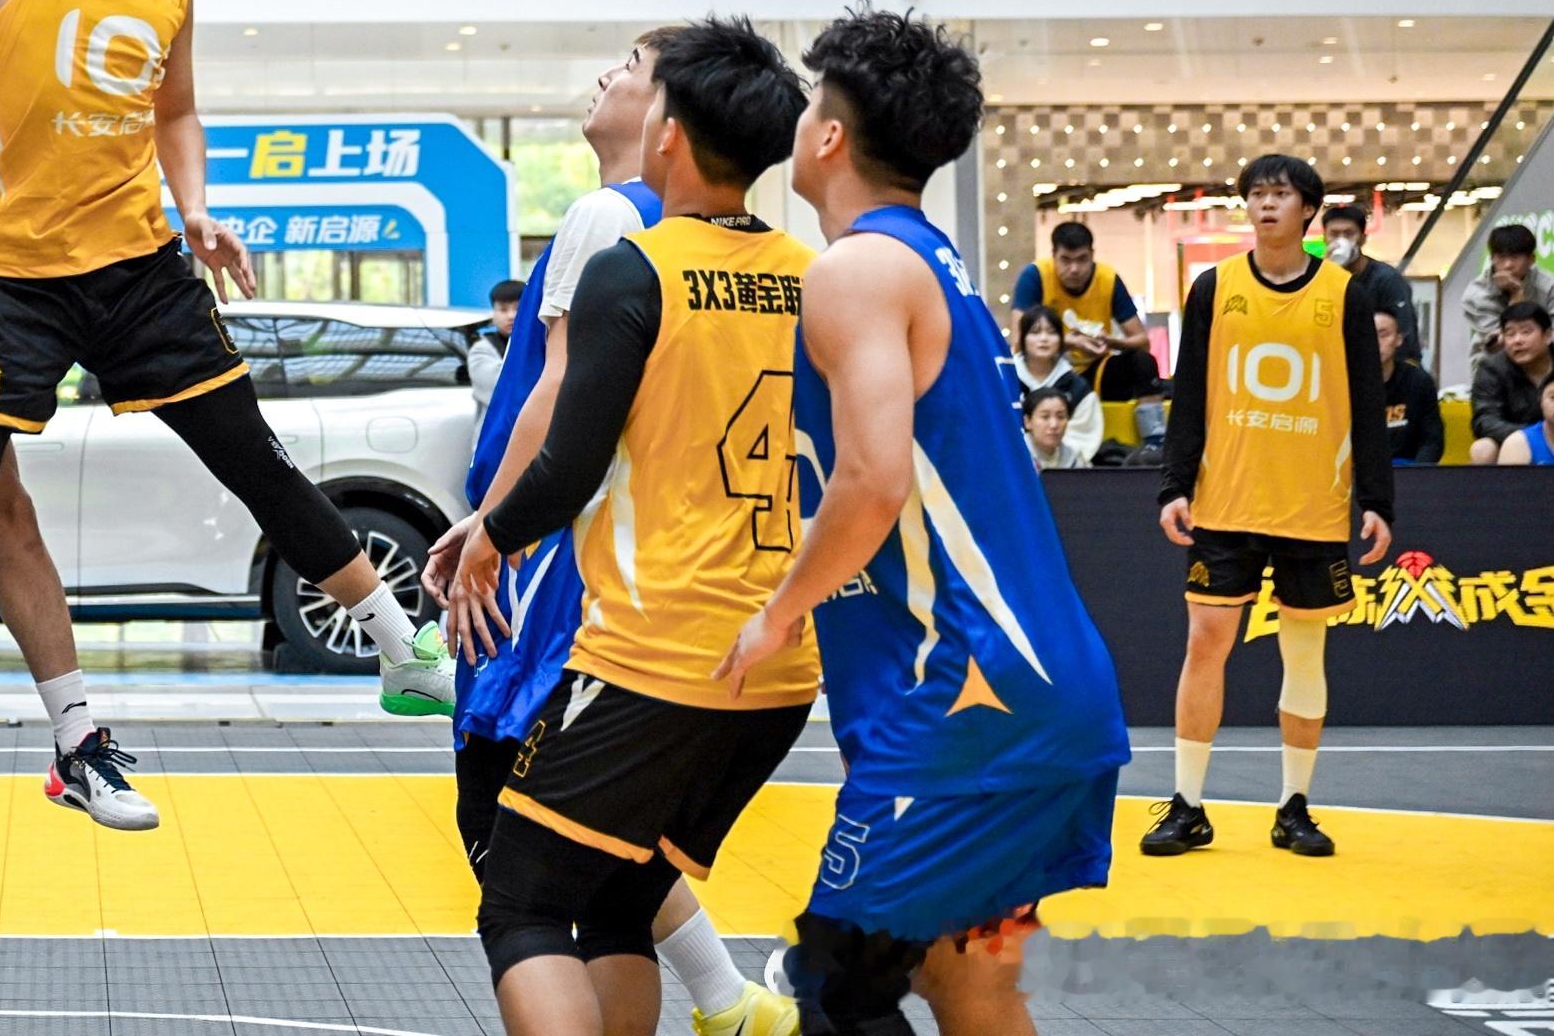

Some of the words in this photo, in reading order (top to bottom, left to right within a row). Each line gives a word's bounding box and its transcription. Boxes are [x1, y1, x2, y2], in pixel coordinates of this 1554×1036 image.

[710, 216, 736, 228] NIKE
[682, 269, 803, 316] 3X3黄金联
[1226, 408, 1319, 436] 长安启源
[716, 370, 797, 553] 4
